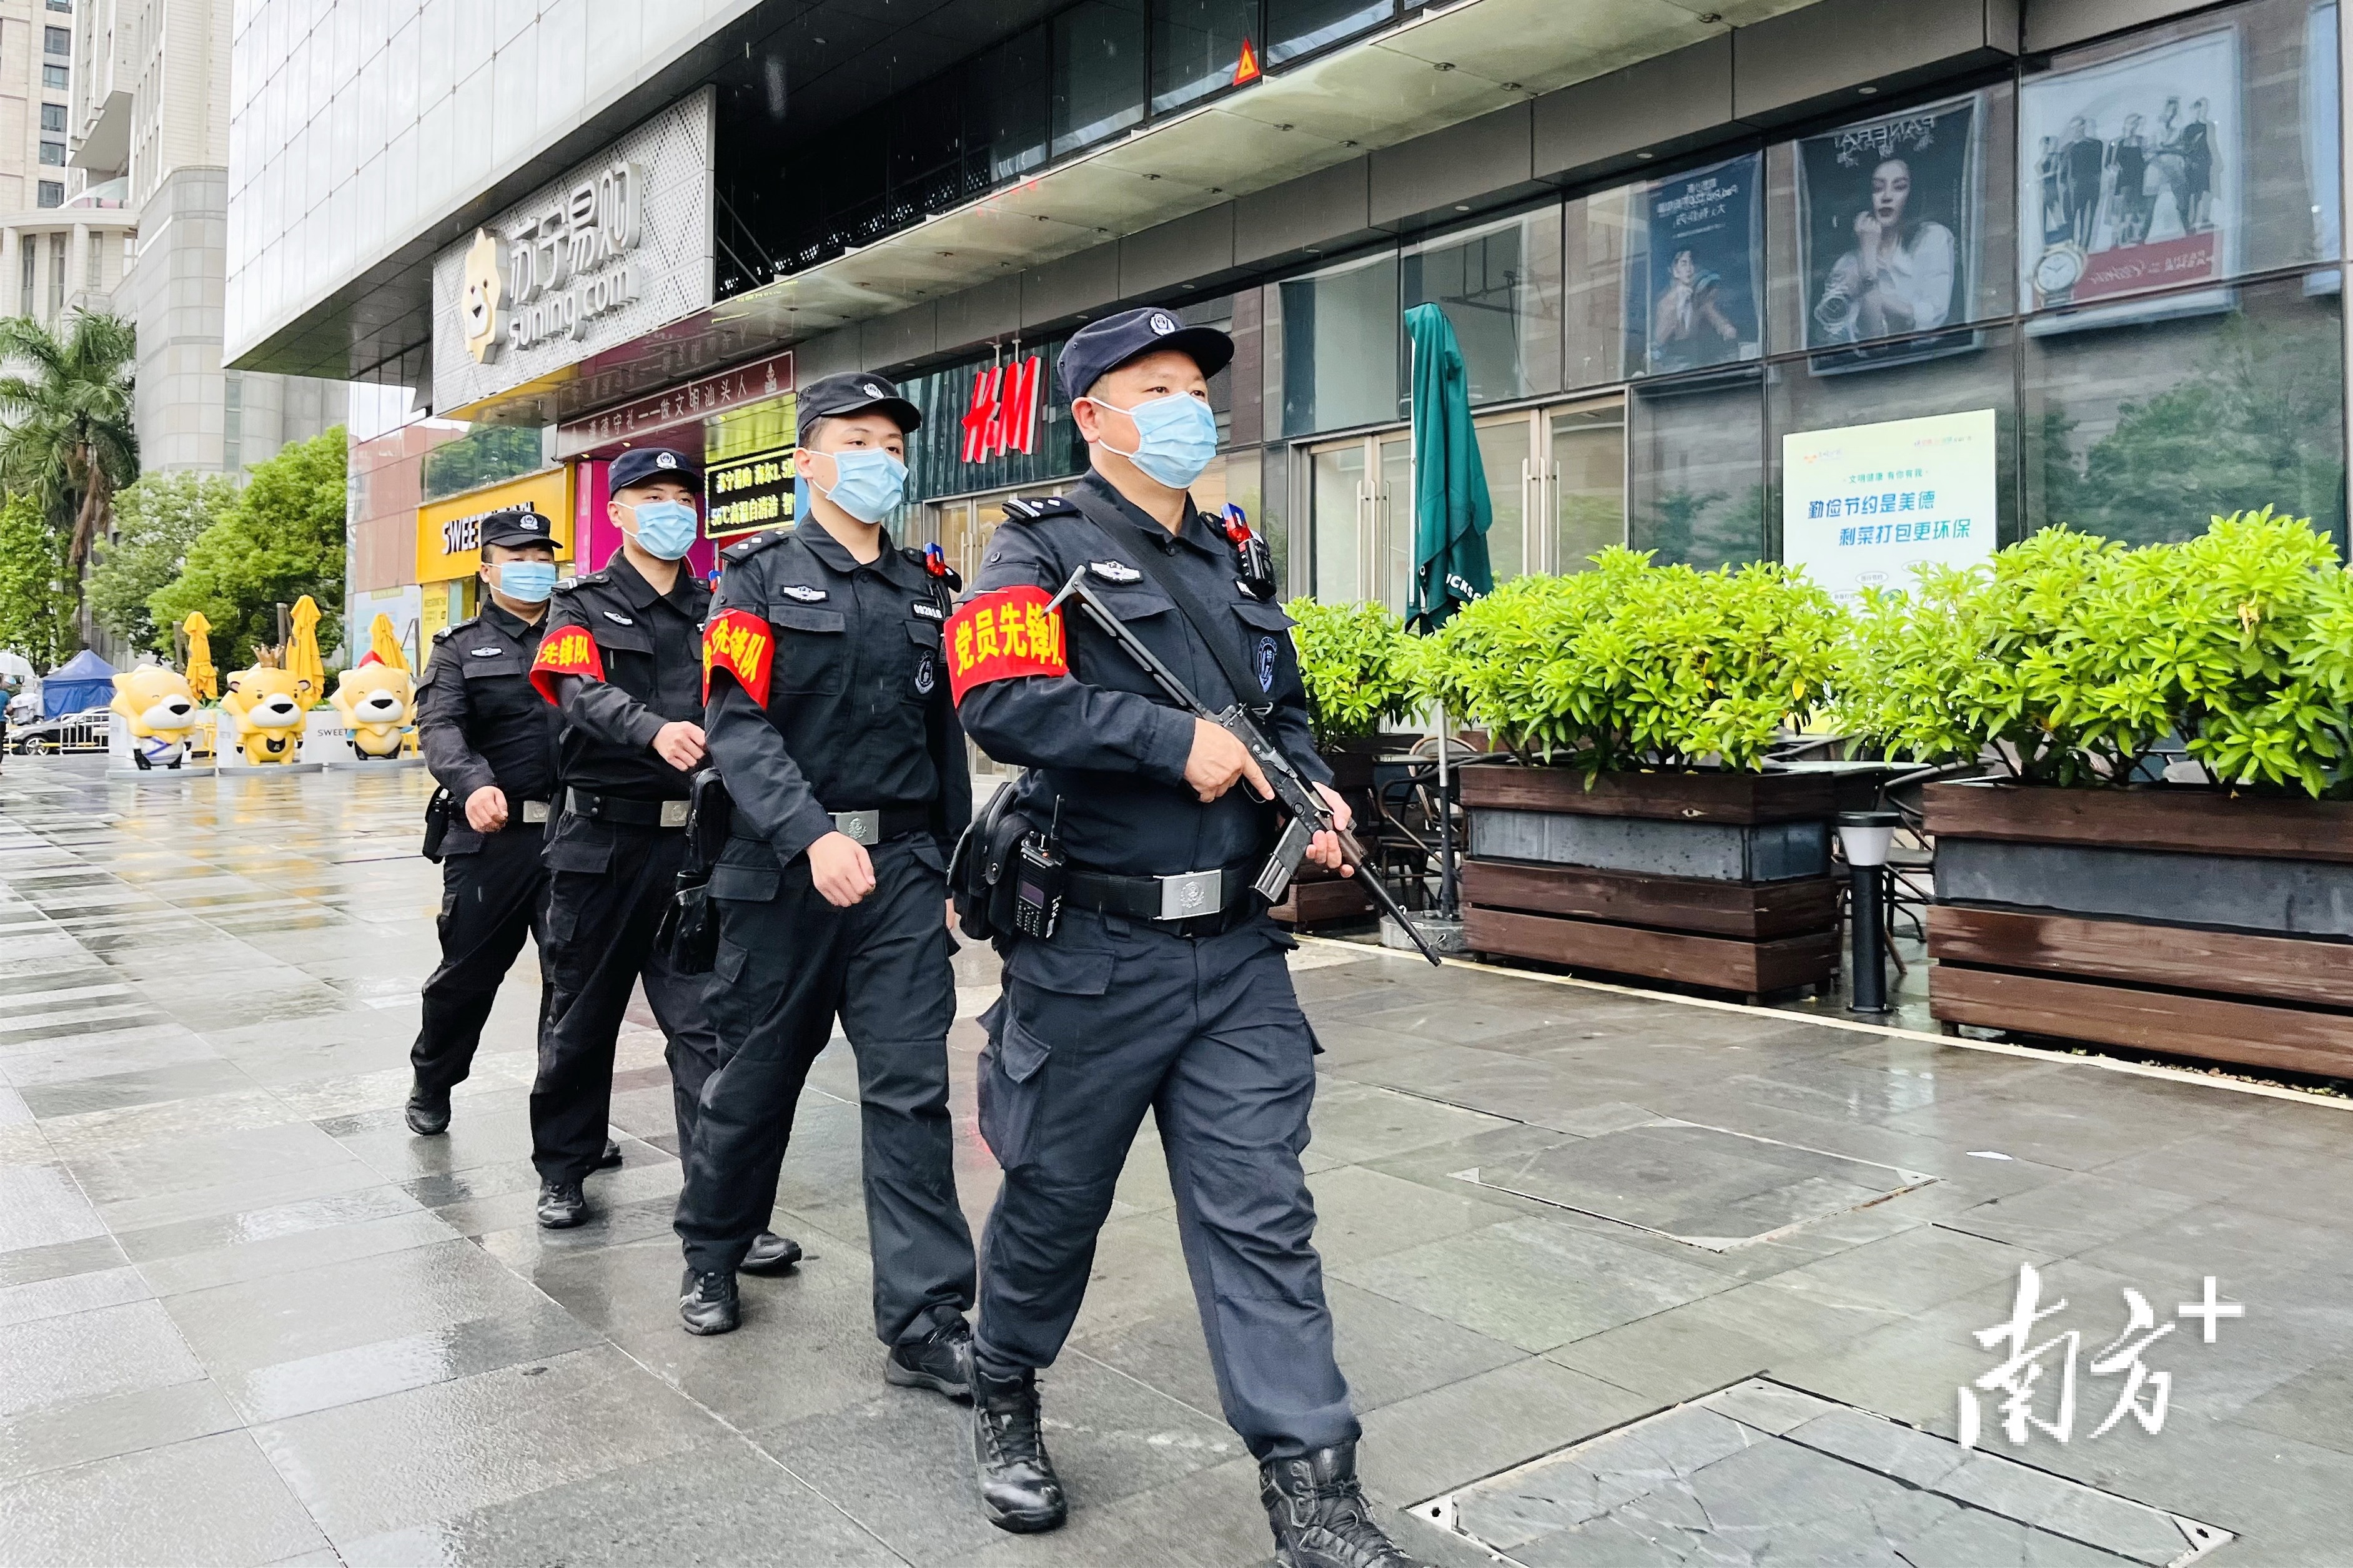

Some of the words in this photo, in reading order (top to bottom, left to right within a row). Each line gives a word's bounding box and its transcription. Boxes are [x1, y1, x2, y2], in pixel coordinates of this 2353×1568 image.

[509, 160, 632, 305] 苏宁易购
[508, 265, 631, 352] suning.com
[961, 355, 1041, 463] H&M
[1849, 472, 1883, 484] 文明健康
[782, 491, 796, 515] 智
[1808, 490, 1936, 520] 勤俭节约是美德
[1838, 518, 1971, 546] 剩菜打包更环保
[534, 634, 590, 667] 先锋队
[954, 601, 1064, 678] 党员先锋队
